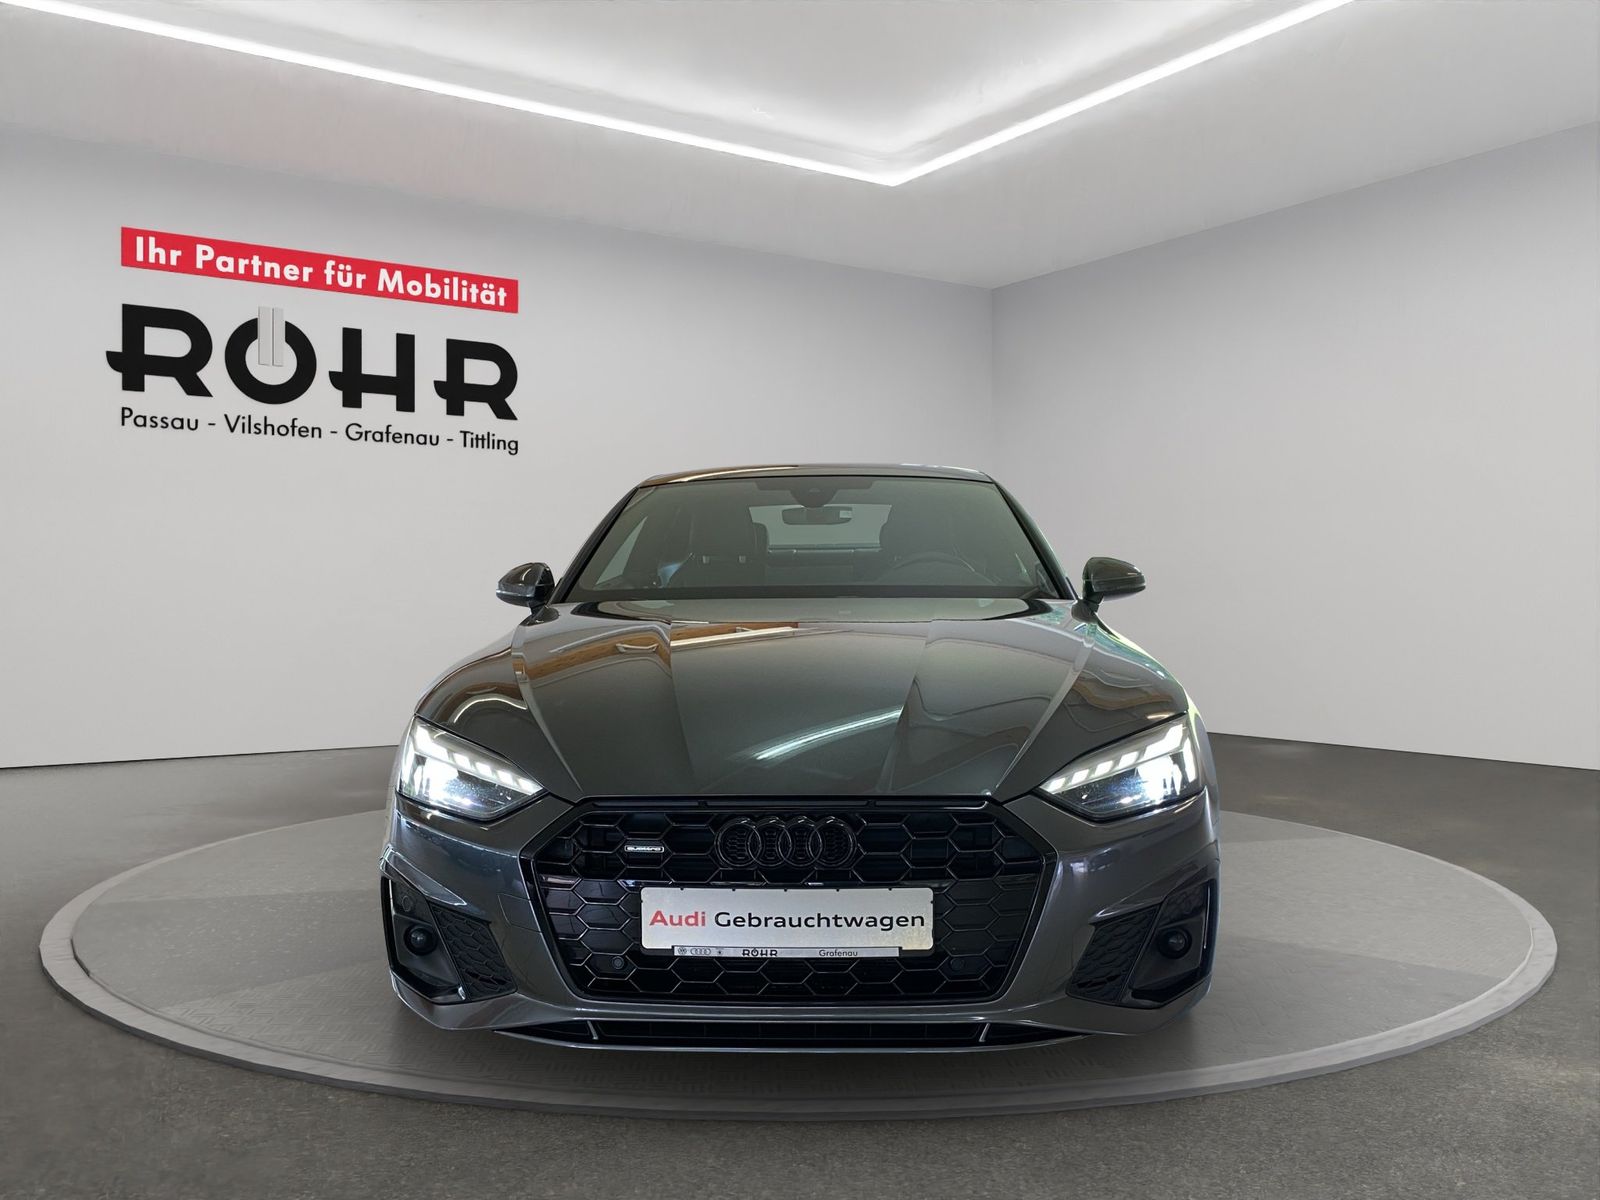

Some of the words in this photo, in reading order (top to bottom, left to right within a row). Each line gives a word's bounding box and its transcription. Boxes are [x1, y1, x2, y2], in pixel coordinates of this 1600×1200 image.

[136, 236, 182, 266] Ihr
[195, 244, 313, 283] Partner
[324, 260, 366, 289] für
[378, 269, 507, 306] Mobilität
[106, 303, 518, 421] RÖHR
[121, 407, 199, 431] Passau
[224, 414, 322, 439] Vilshofen
[345, 423, 440, 447] Grafenau
[460, 431, 519, 456] Tittling
[649, 910, 707, 927] Audi
[714, 911, 925, 931] Gebrauchtwagen
[742, 948, 778, 957] RÖHR
[818, 948, 858, 957] Grafenau
